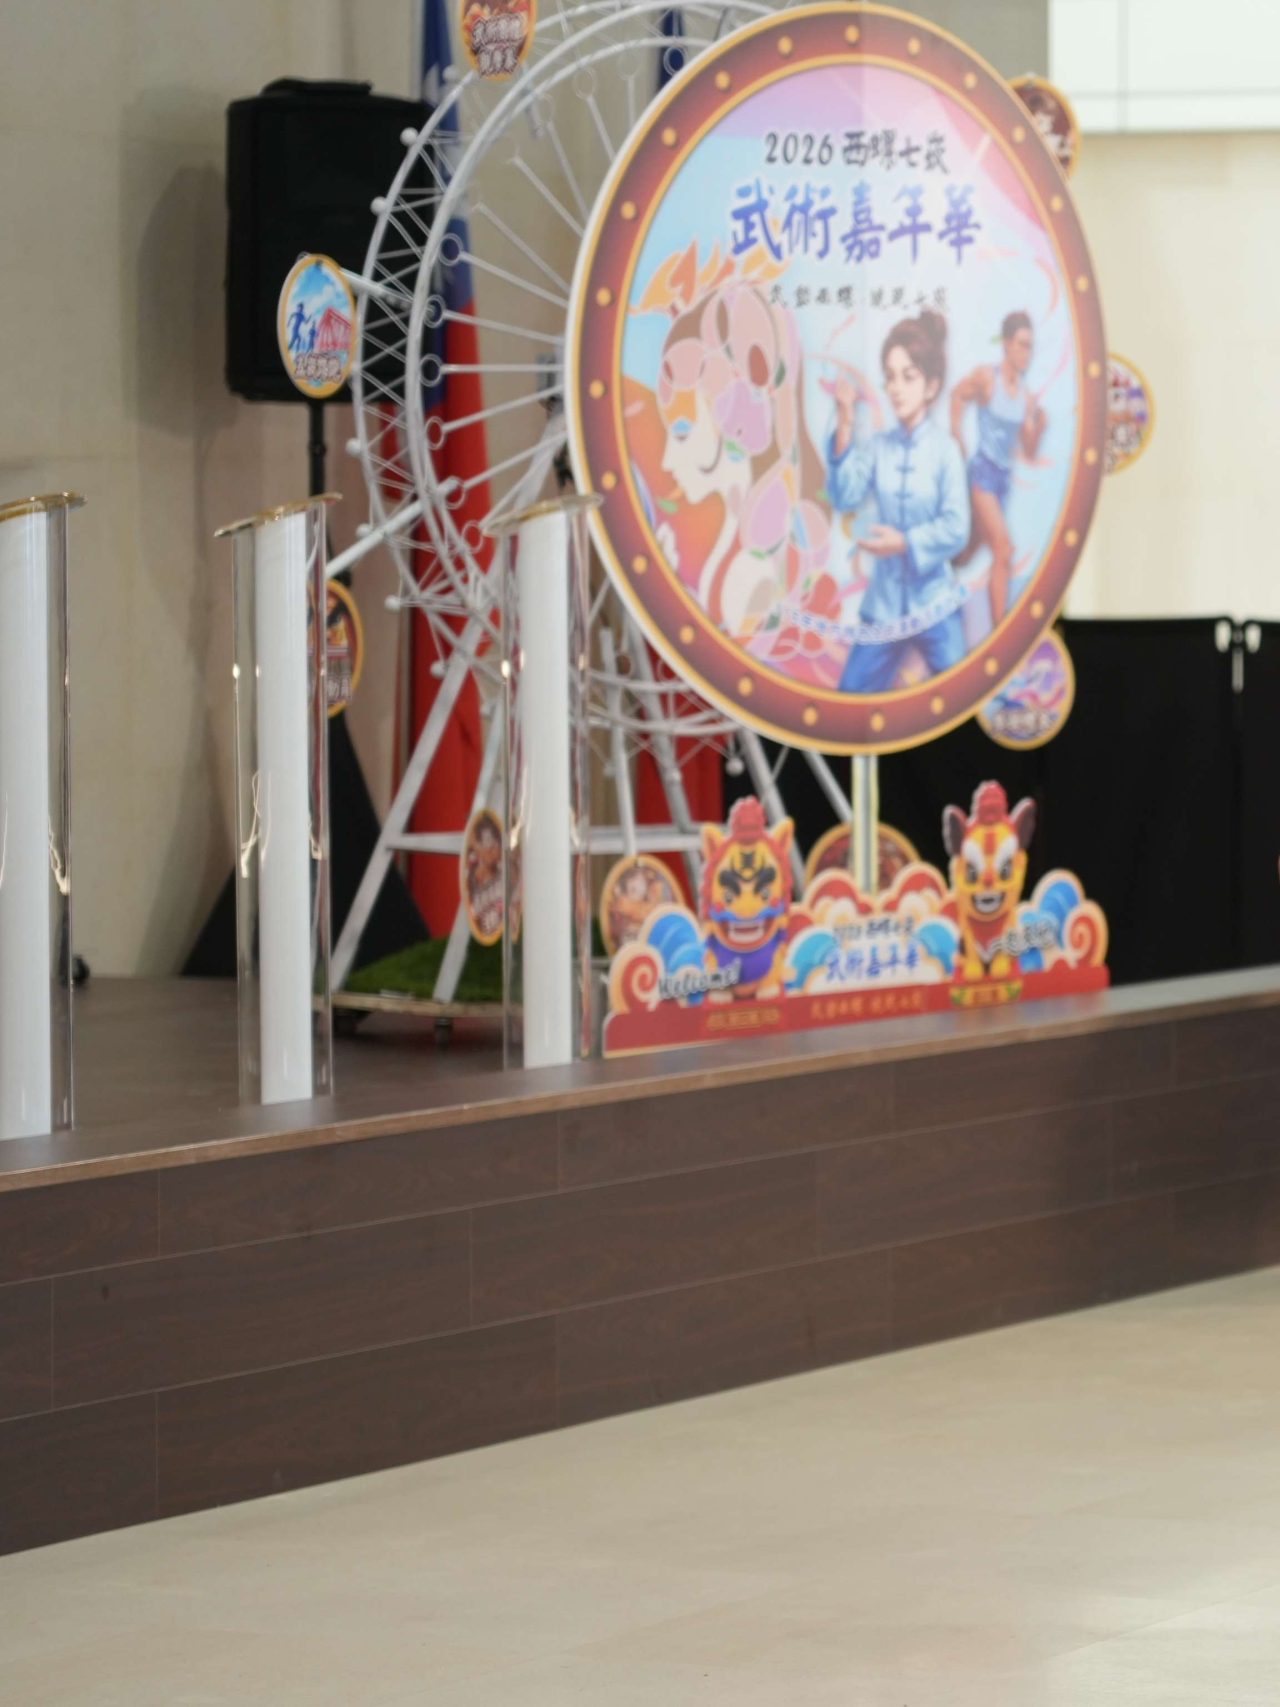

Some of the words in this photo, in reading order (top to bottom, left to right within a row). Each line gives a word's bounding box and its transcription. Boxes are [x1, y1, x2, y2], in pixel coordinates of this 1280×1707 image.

[764, 131, 834, 165] 2026
[731, 177, 981, 265] 武術嘉年華
